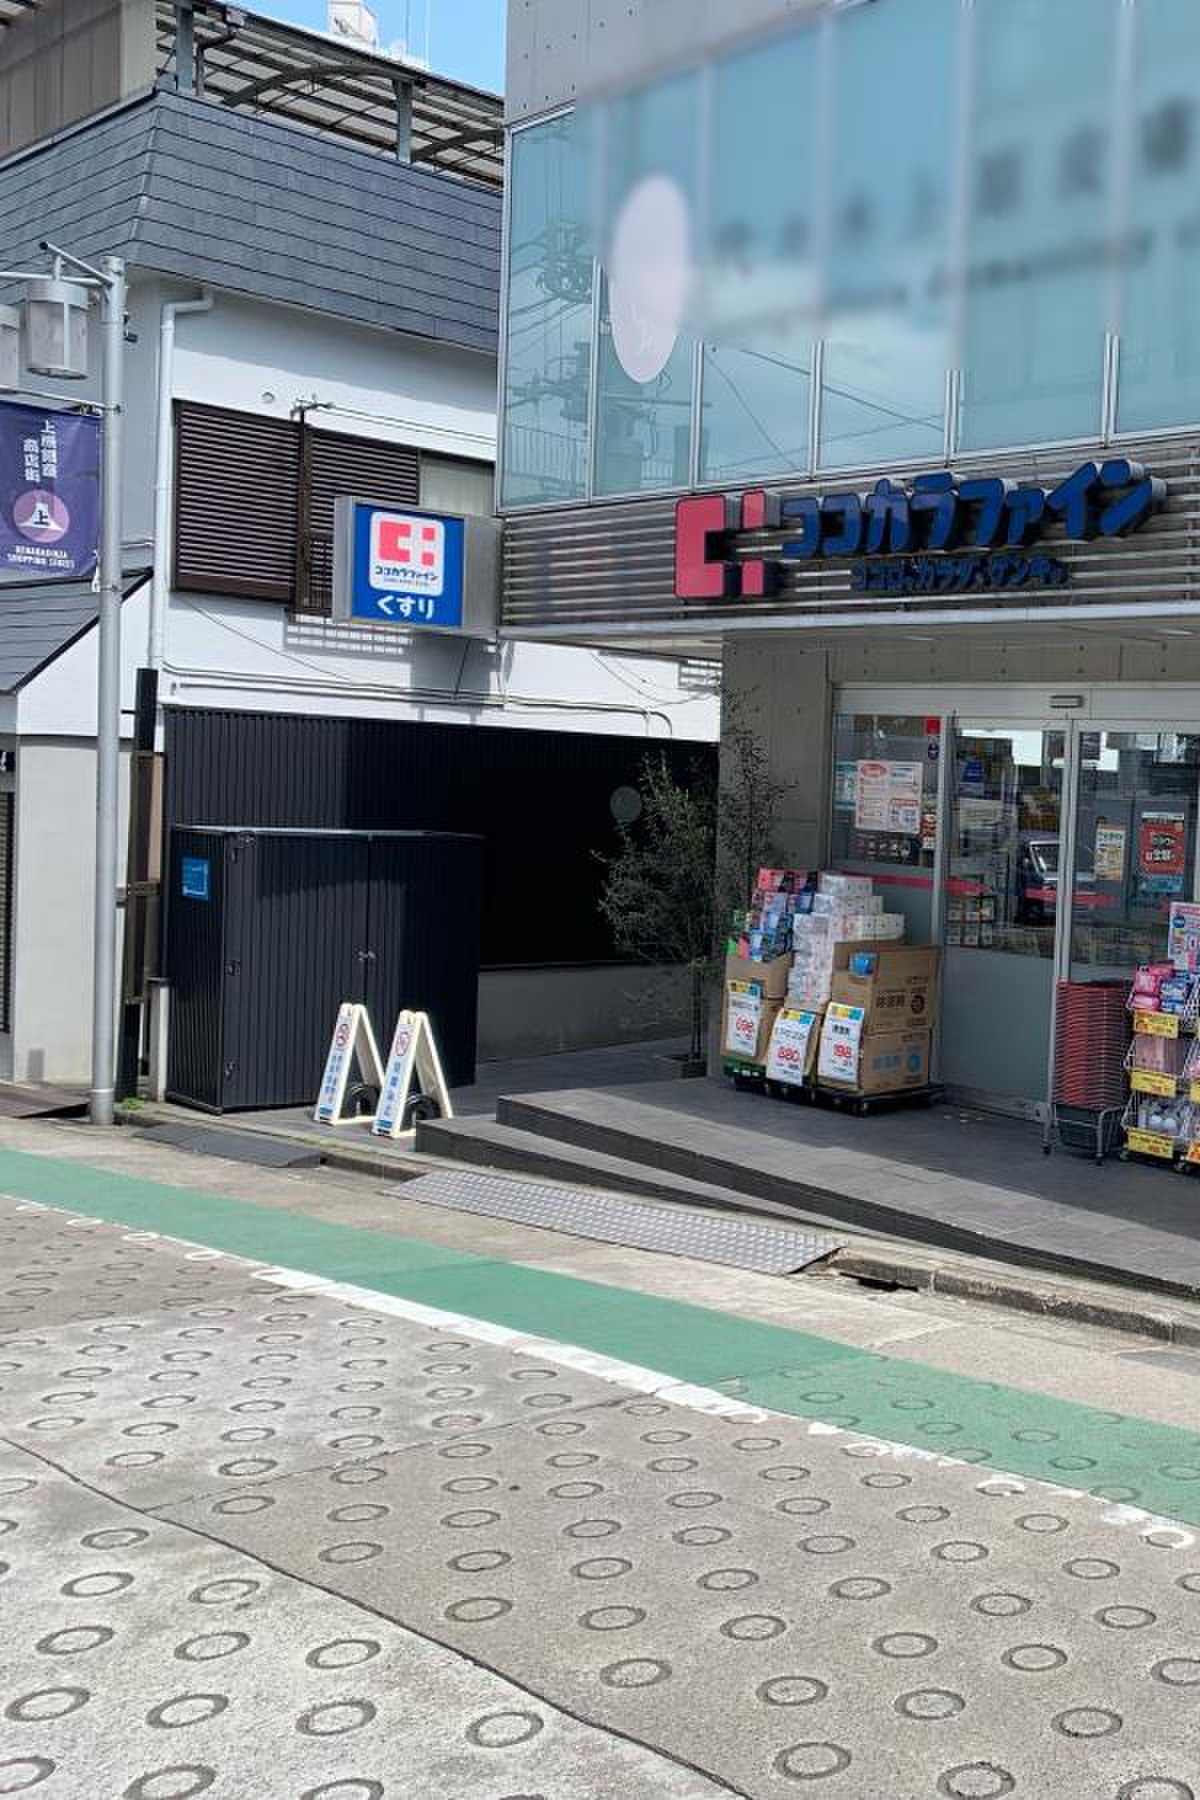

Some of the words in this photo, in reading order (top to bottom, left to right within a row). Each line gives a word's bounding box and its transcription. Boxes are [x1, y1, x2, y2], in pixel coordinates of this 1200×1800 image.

[782, 459, 1158, 559] ココカラファイン
[378, 595, 434, 619] くすり
